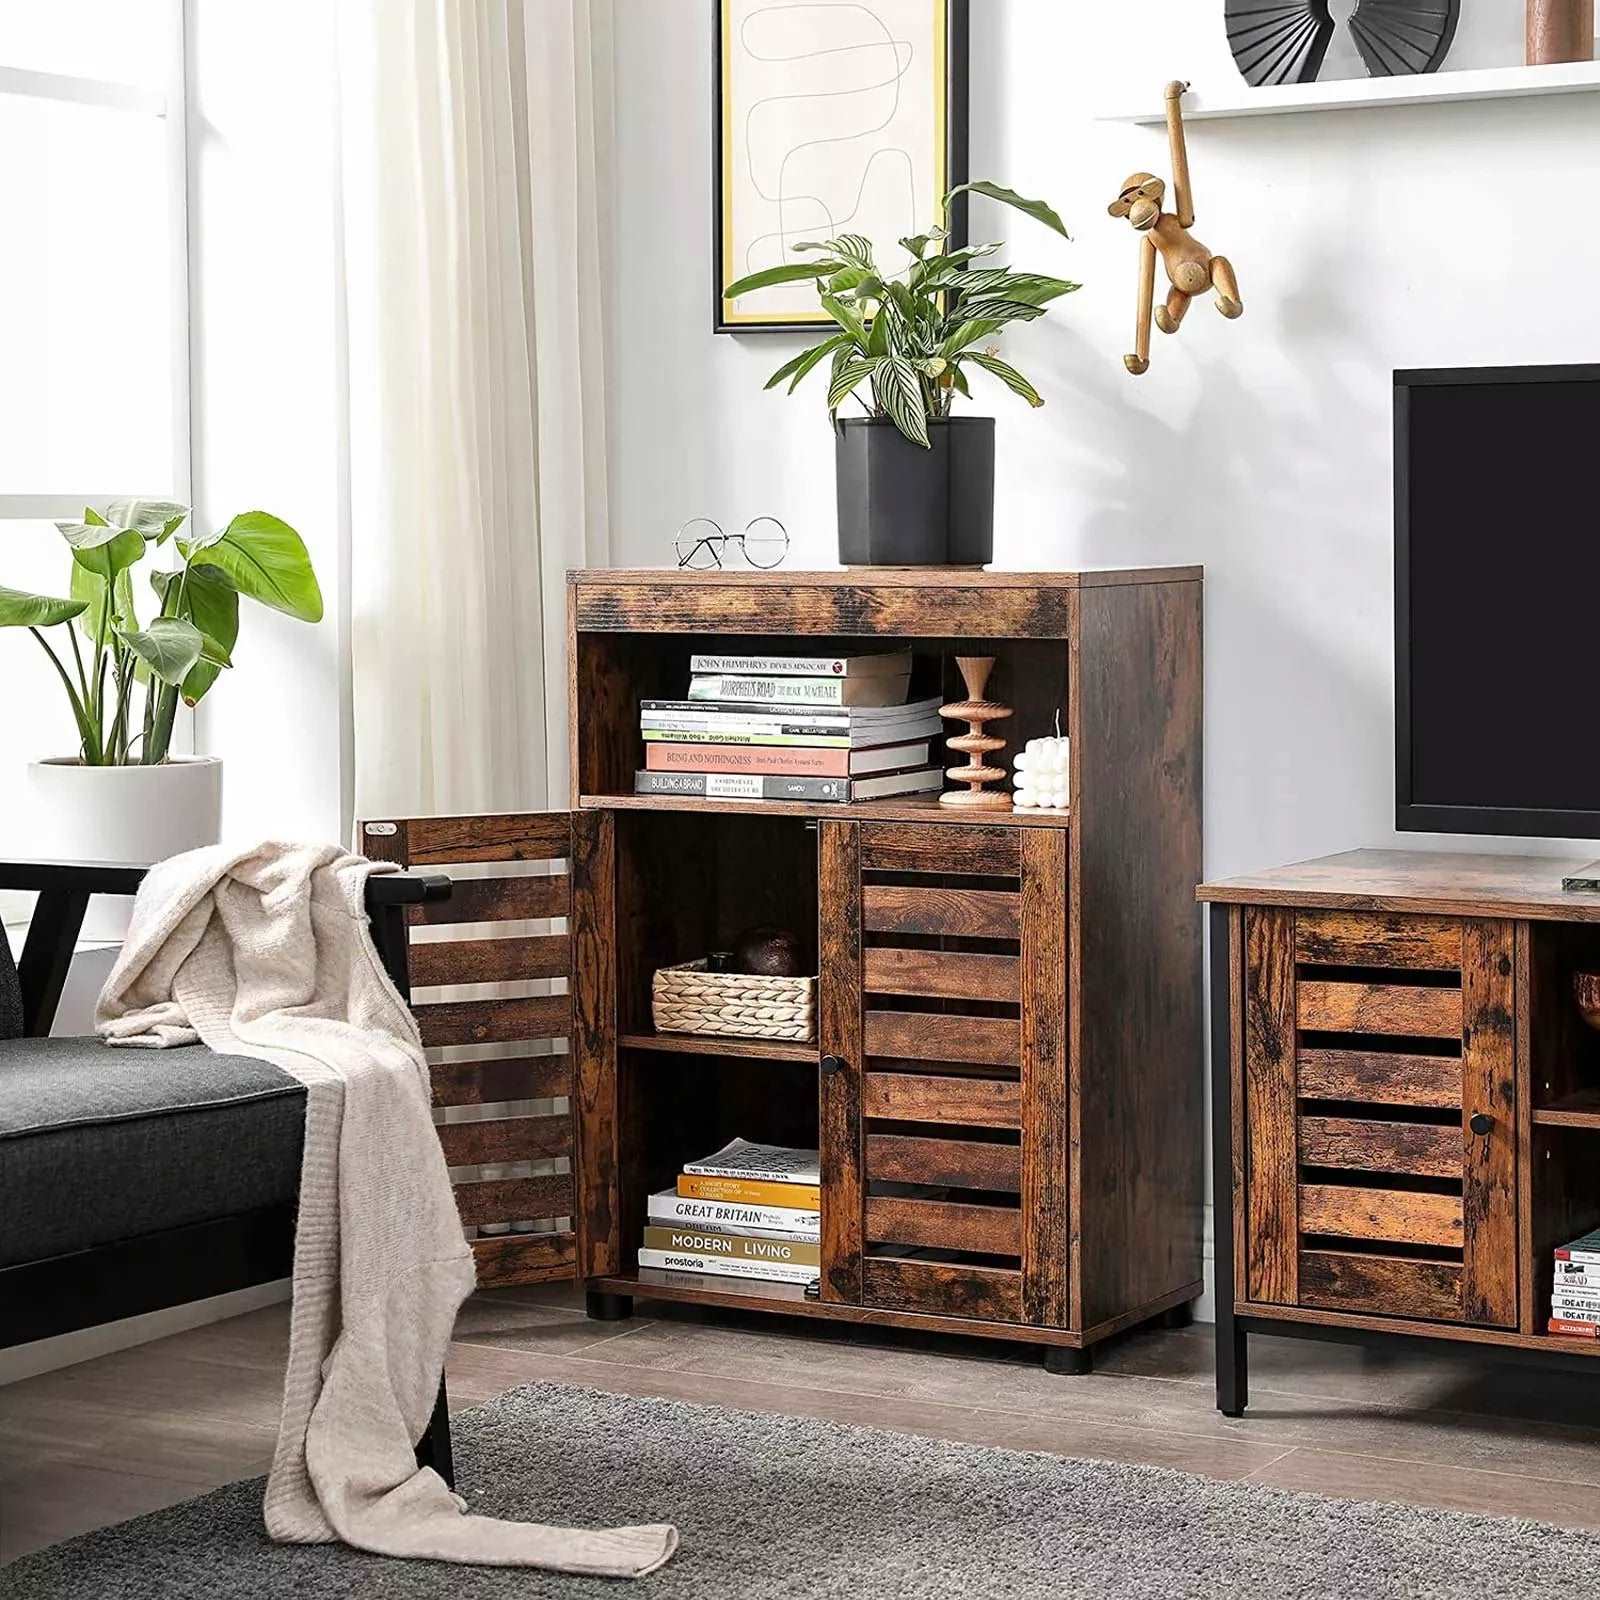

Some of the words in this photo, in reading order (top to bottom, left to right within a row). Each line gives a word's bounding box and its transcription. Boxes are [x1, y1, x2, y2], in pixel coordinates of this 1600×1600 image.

[697, 659, 720, 669] JOHN
[722, 660, 767, 669] HUMPHRYS
[757, 681, 776, 698] ROAD
[666, 752, 688, 762] BEING
[689, 753, 704, 763] AND
[703, 754, 752, 765] NOTHINGNESS
[675, 1203, 714, 1218] GREAT
[715, 1207, 762, 1223] BRITAIN
[672, 1234, 732, 1252] MODERN
[744, 1242, 792, 1259] LIVING
[665, 1257, 704, 1268] prostoria
[1561, 1298, 1585, 1308] IDEAT
[1562, 1311, 1586, 1320] IDEAT
